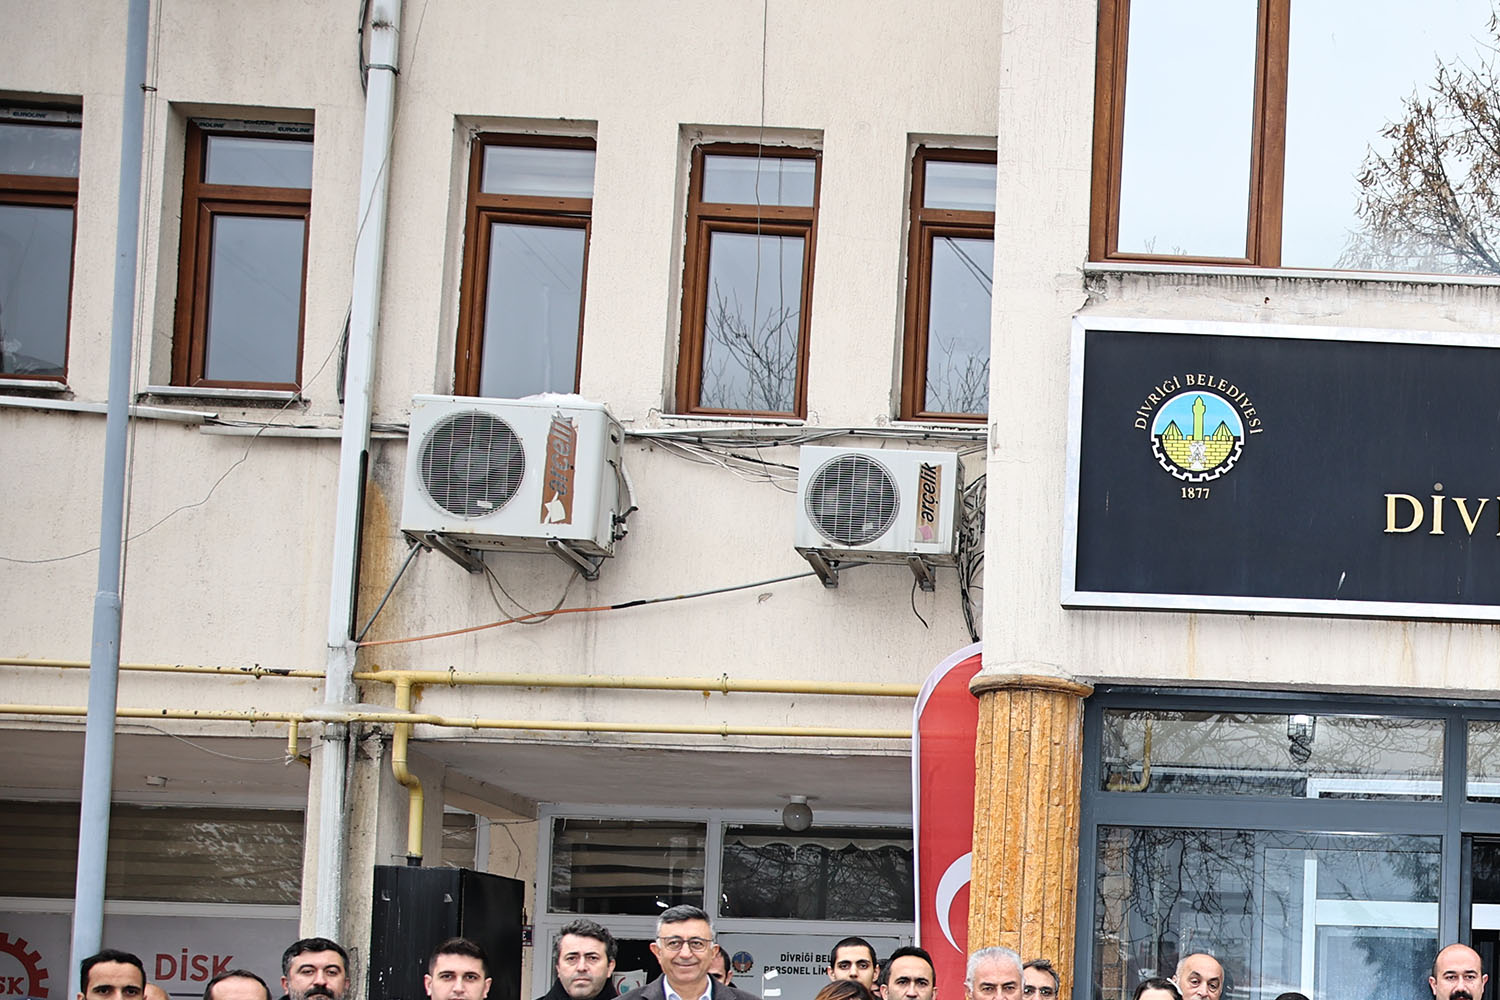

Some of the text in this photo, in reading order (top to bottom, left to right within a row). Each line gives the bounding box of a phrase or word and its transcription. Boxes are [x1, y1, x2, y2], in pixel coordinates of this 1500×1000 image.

[1134, 373, 1263, 435] DİVRİĞİ BELEDİYESİ
[920, 462, 939, 523] arçelik
[1181, 487, 1210, 499] 1877
[780, 952, 831, 963] DİVRİĞİ BEL
[763, 965, 828, 975] PERSONEL LİM
